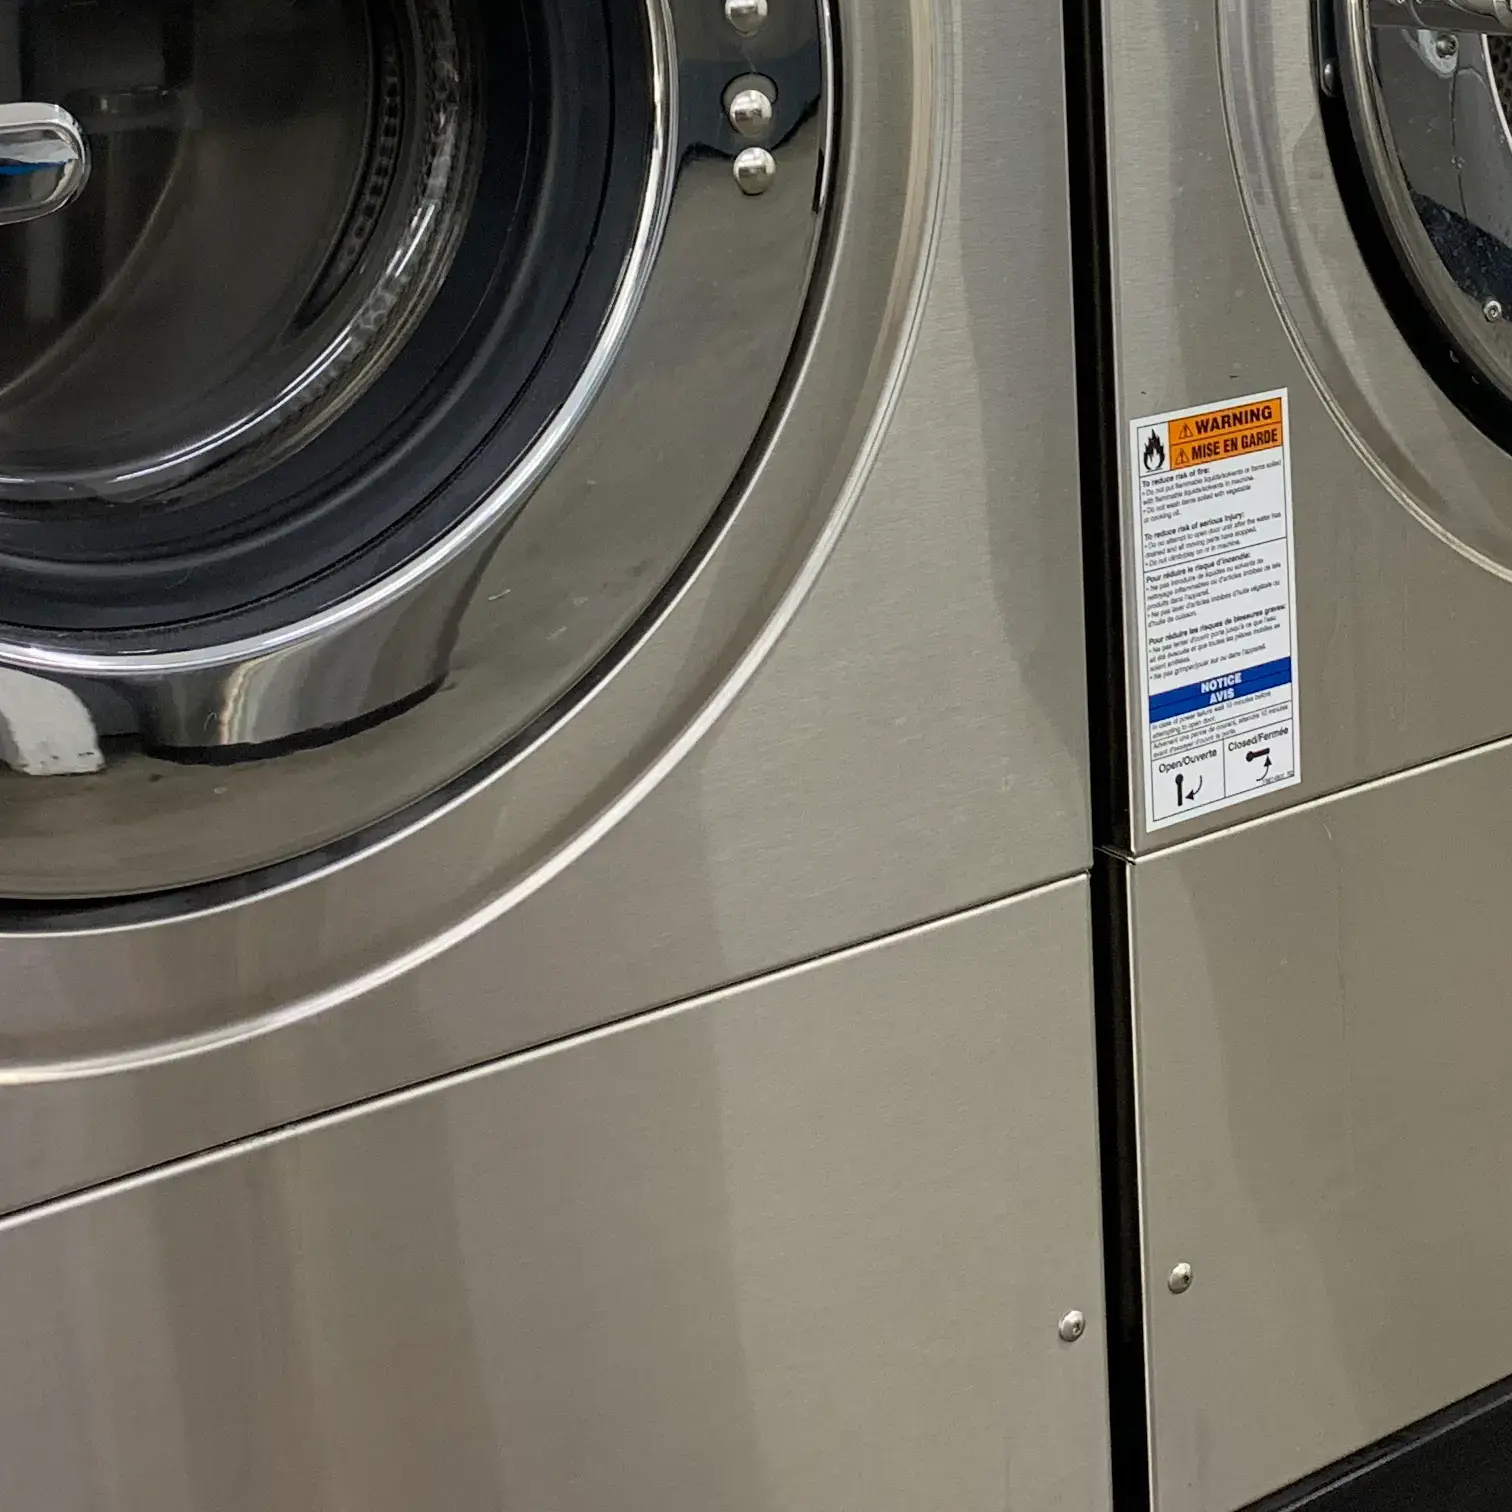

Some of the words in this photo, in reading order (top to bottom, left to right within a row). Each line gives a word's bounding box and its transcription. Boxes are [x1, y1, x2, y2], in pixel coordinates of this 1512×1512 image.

[1195, 406, 1272, 433] WARNING
[1191, 441, 1220, 459] MISE
[1223, 437, 1238, 453] EN
[1241, 429, 1277, 449] GARDE
[1201, 672, 1241, 693] NOTICE
[1209, 688, 1234, 703] AVIS
[1228, 727, 1288, 751] Closed/Fermée
[1158, 749, 1217, 773] Open/Ouverte
